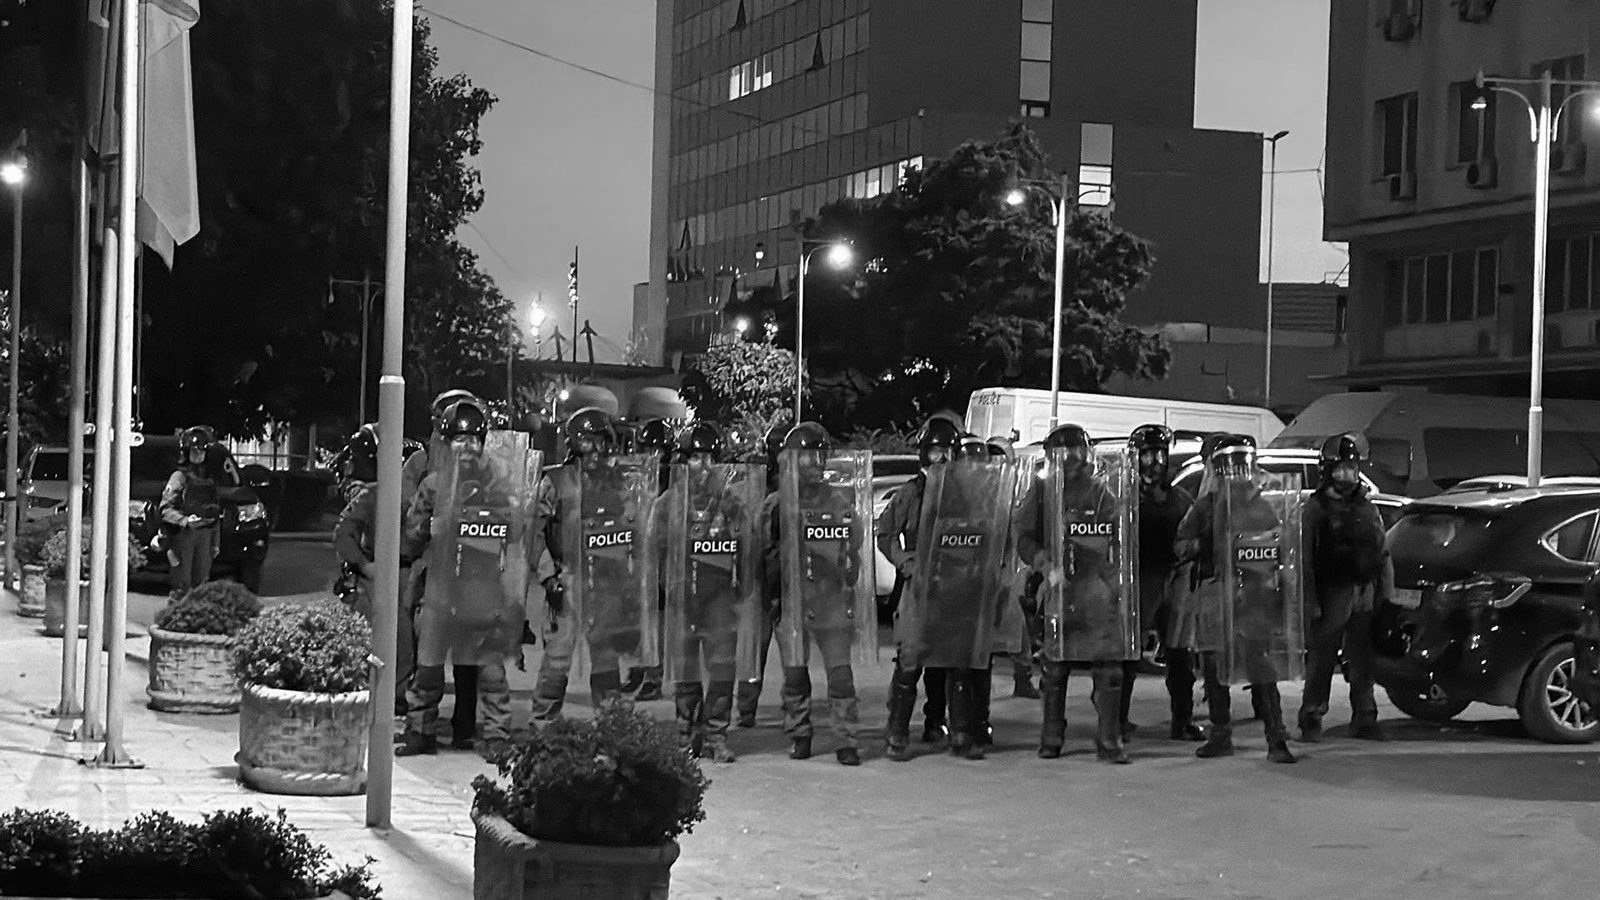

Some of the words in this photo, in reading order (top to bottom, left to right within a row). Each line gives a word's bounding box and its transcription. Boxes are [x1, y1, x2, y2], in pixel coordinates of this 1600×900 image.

[979, 394, 1001, 405] POLICE
[460, 524, 507, 537] POLICE
[807, 527, 850, 539] POLICE
[1070, 523, 1112, 535] POLICE
[589, 531, 632, 547] POLICE
[941, 534, 982, 546] POLICE
[694, 541, 737, 553] POLICE
[1238, 547, 1278, 560] POLICE
